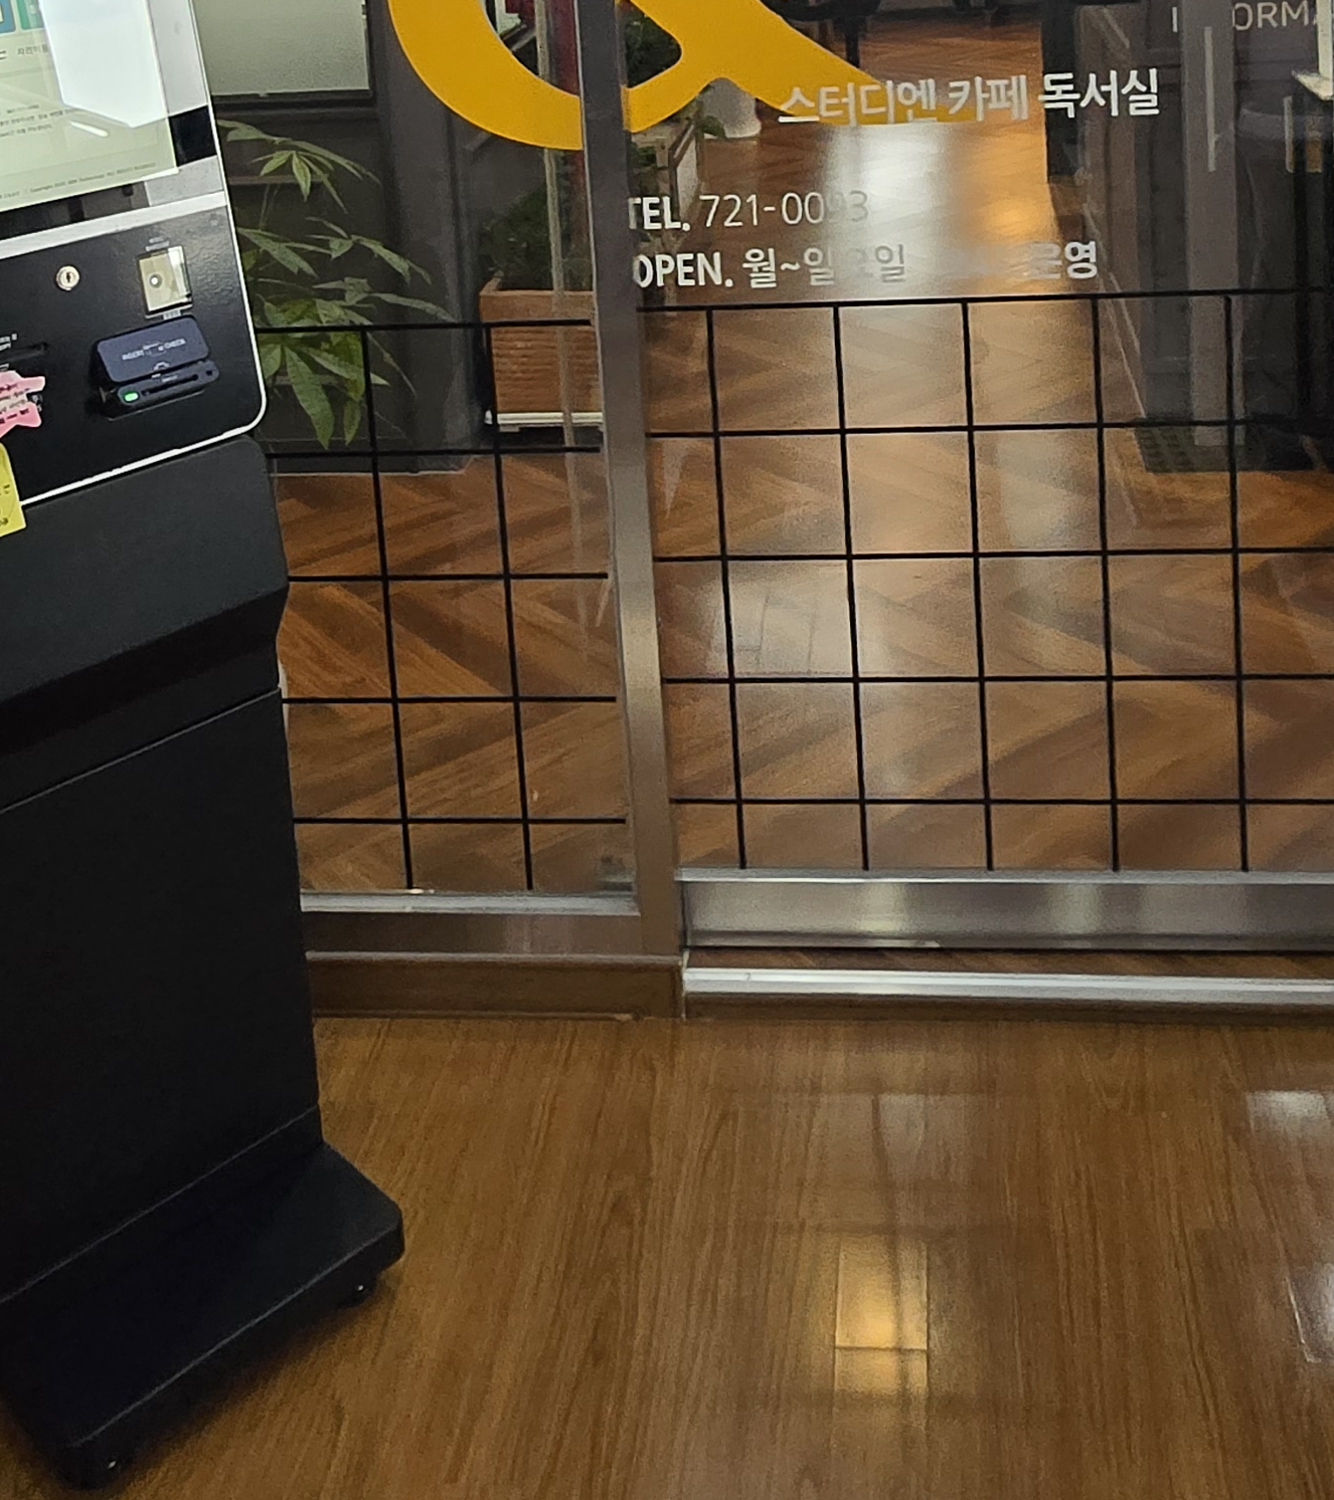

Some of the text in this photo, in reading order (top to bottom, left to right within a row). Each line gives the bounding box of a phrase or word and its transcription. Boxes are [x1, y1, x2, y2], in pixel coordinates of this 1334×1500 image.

[778, 69, 1160, 127] 스터디엔 카페 독서실
[628, 196, 691, 232] TEL.
[632, 254, 734, 289] OPEN.
